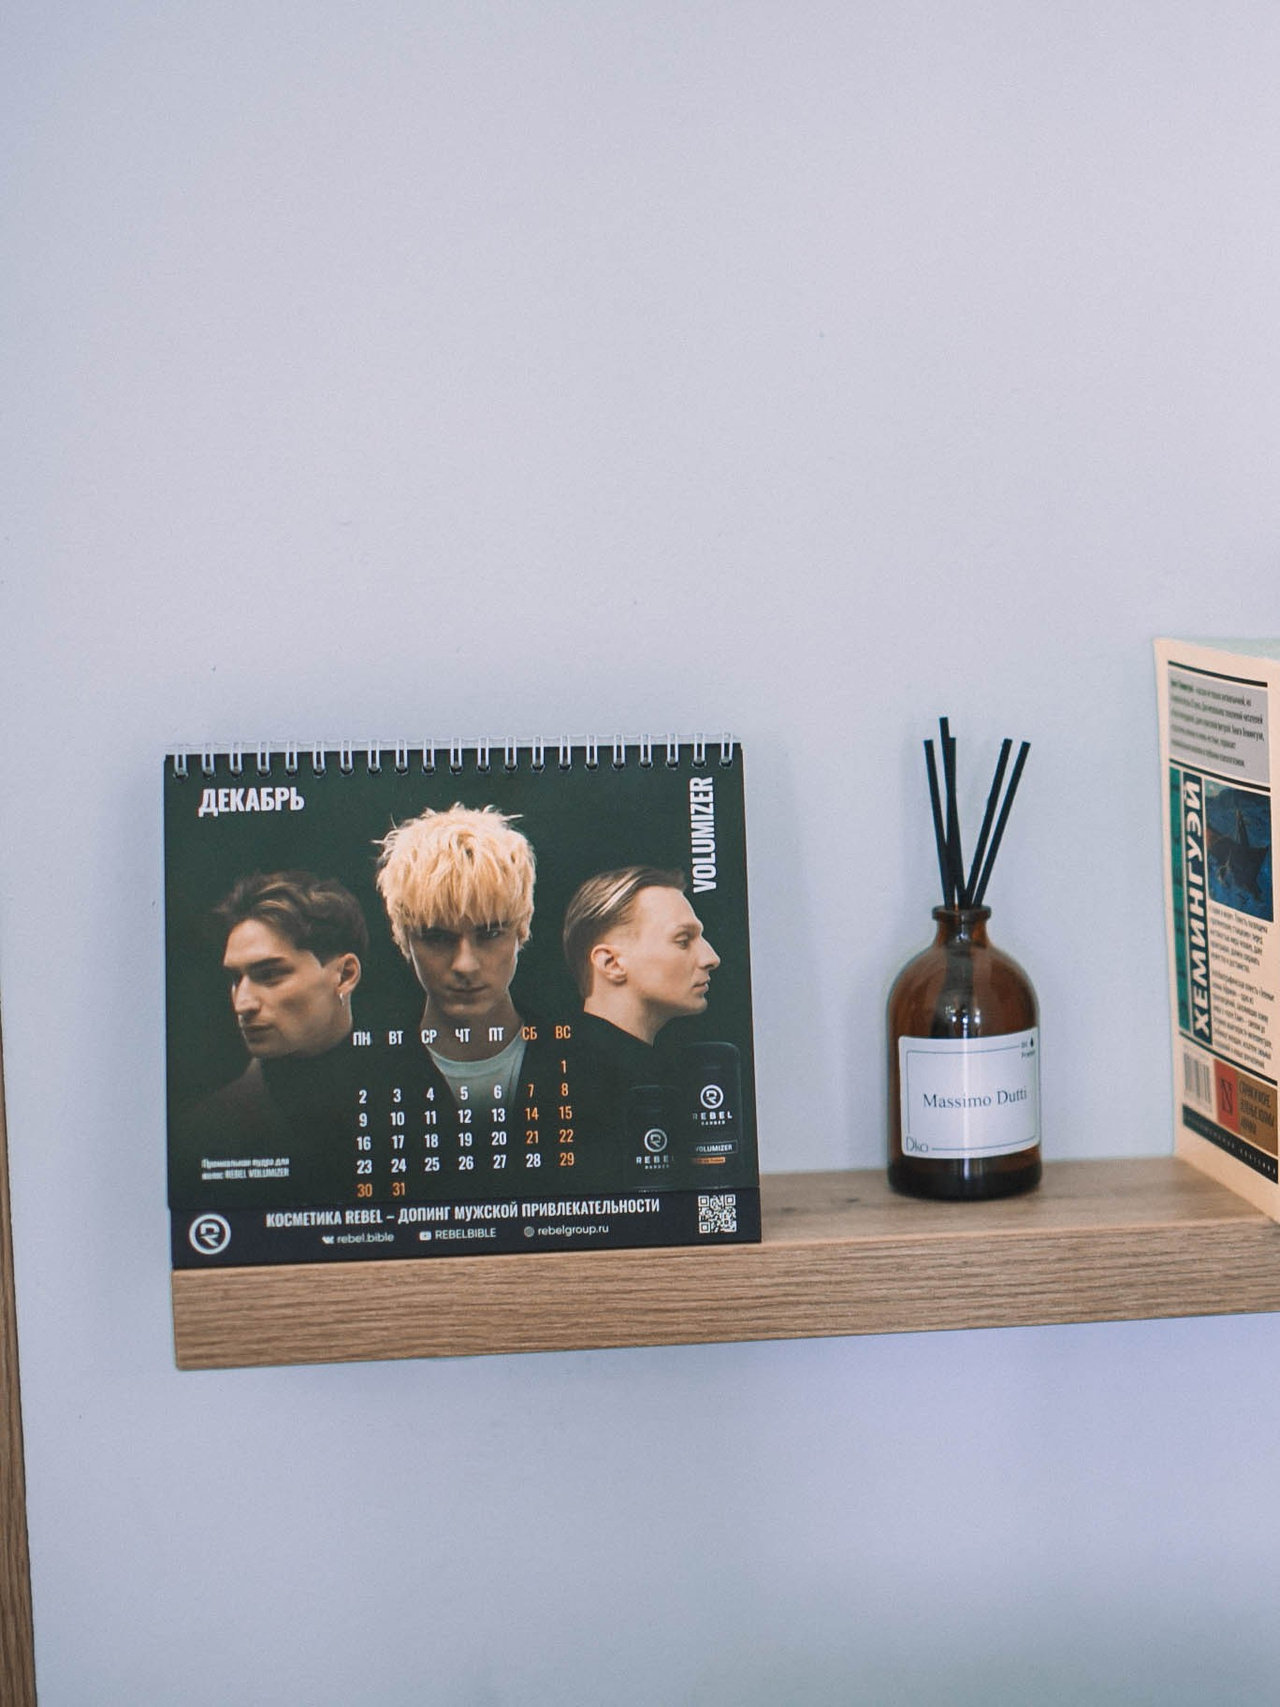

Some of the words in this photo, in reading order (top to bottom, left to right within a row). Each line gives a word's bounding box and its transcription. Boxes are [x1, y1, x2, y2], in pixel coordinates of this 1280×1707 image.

[198, 787, 305, 818] ДЕКАБРЬ
[689, 777, 716, 893] VOLUMIZER
[1184, 780, 1211, 1039] ХЕМИНГУЭЙ
[353, 1031, 371, 1046] ПН
[388, 1030, 404, 1045] ВТ
[421, 1029, 437, 1044] СР
[455, 1028, 471, 1043] ЧТ
[489, 1027, 504, 1042] ПТ
[522, 1026, 538, 1040] СБ
[555, 1025, 571, 1039] ВС
[560, 1060, 567, 1074] 1
[359, 1090, 367, 1104] 2
[393, 1088, 401, 1103] 3
[426, 1087, 435, 1101] 4
[460, 1086, 468, 1100] 5
[494, 1085, 502, 1099] 6
[527, 1084, 535, 1097] 7
[561, 1082, 569, 1096] 8
[922, 1093, 992, 1108] Massimo
[997, 1086, 1027, 1105] Dutti
[359, 1113, 367, 1127] 9
[390, 1112, 405, 1126] 10
[424, 1110, 437, 1124] 11
[458, 1109, 472, 1124] 12
[492, 1108, 506, 1122] 13
[525, 1107, 539, 1121] 14
[558, 1106, 573, 1120] 15
[356, 1136, 371, 1151] 16
[391, 1135, 405, 1149] 17
[424, 1134, 439, 1148] 18
[458, 1132, 473, 1147] 19
[492, 1131, 507, 1146] 20
[526, 1130, 539, 1144] 21
[559, 1129, 574, 1143] 22
[357, 1160, 373, 1174] 23
[391, 1158, 407, 1173] 24
[424, 1157, 440, 1172] 25
[458, 1156, 474, 1171] 26
[493, 1154, 507, 1169] 27
[526, 1154, 542, 1168] 28
[560, 1152, 575, 1167] 29
[357, 1183, 373, 1198] 30
[392, 1182, 406, 1196] 31
[265, 1211, 342, 1228] КОСМЕТИКА
[345, 1209, 383, 1225] REBEL
[397, 1206, 451, 1225] ДОПИНГ
[454, 1201, 519, 1222] МУЖСКОЙ
[521, 1198, 660, 1218] ПРИВЛЕКАТЕЛЬНОСТИ
[337, 1232, 395, 1244] rebel.bible
[435, 1227, 497, 1240] REBELBIBLE
[538, 1224, 609, 1238] rebelgroup.ru
